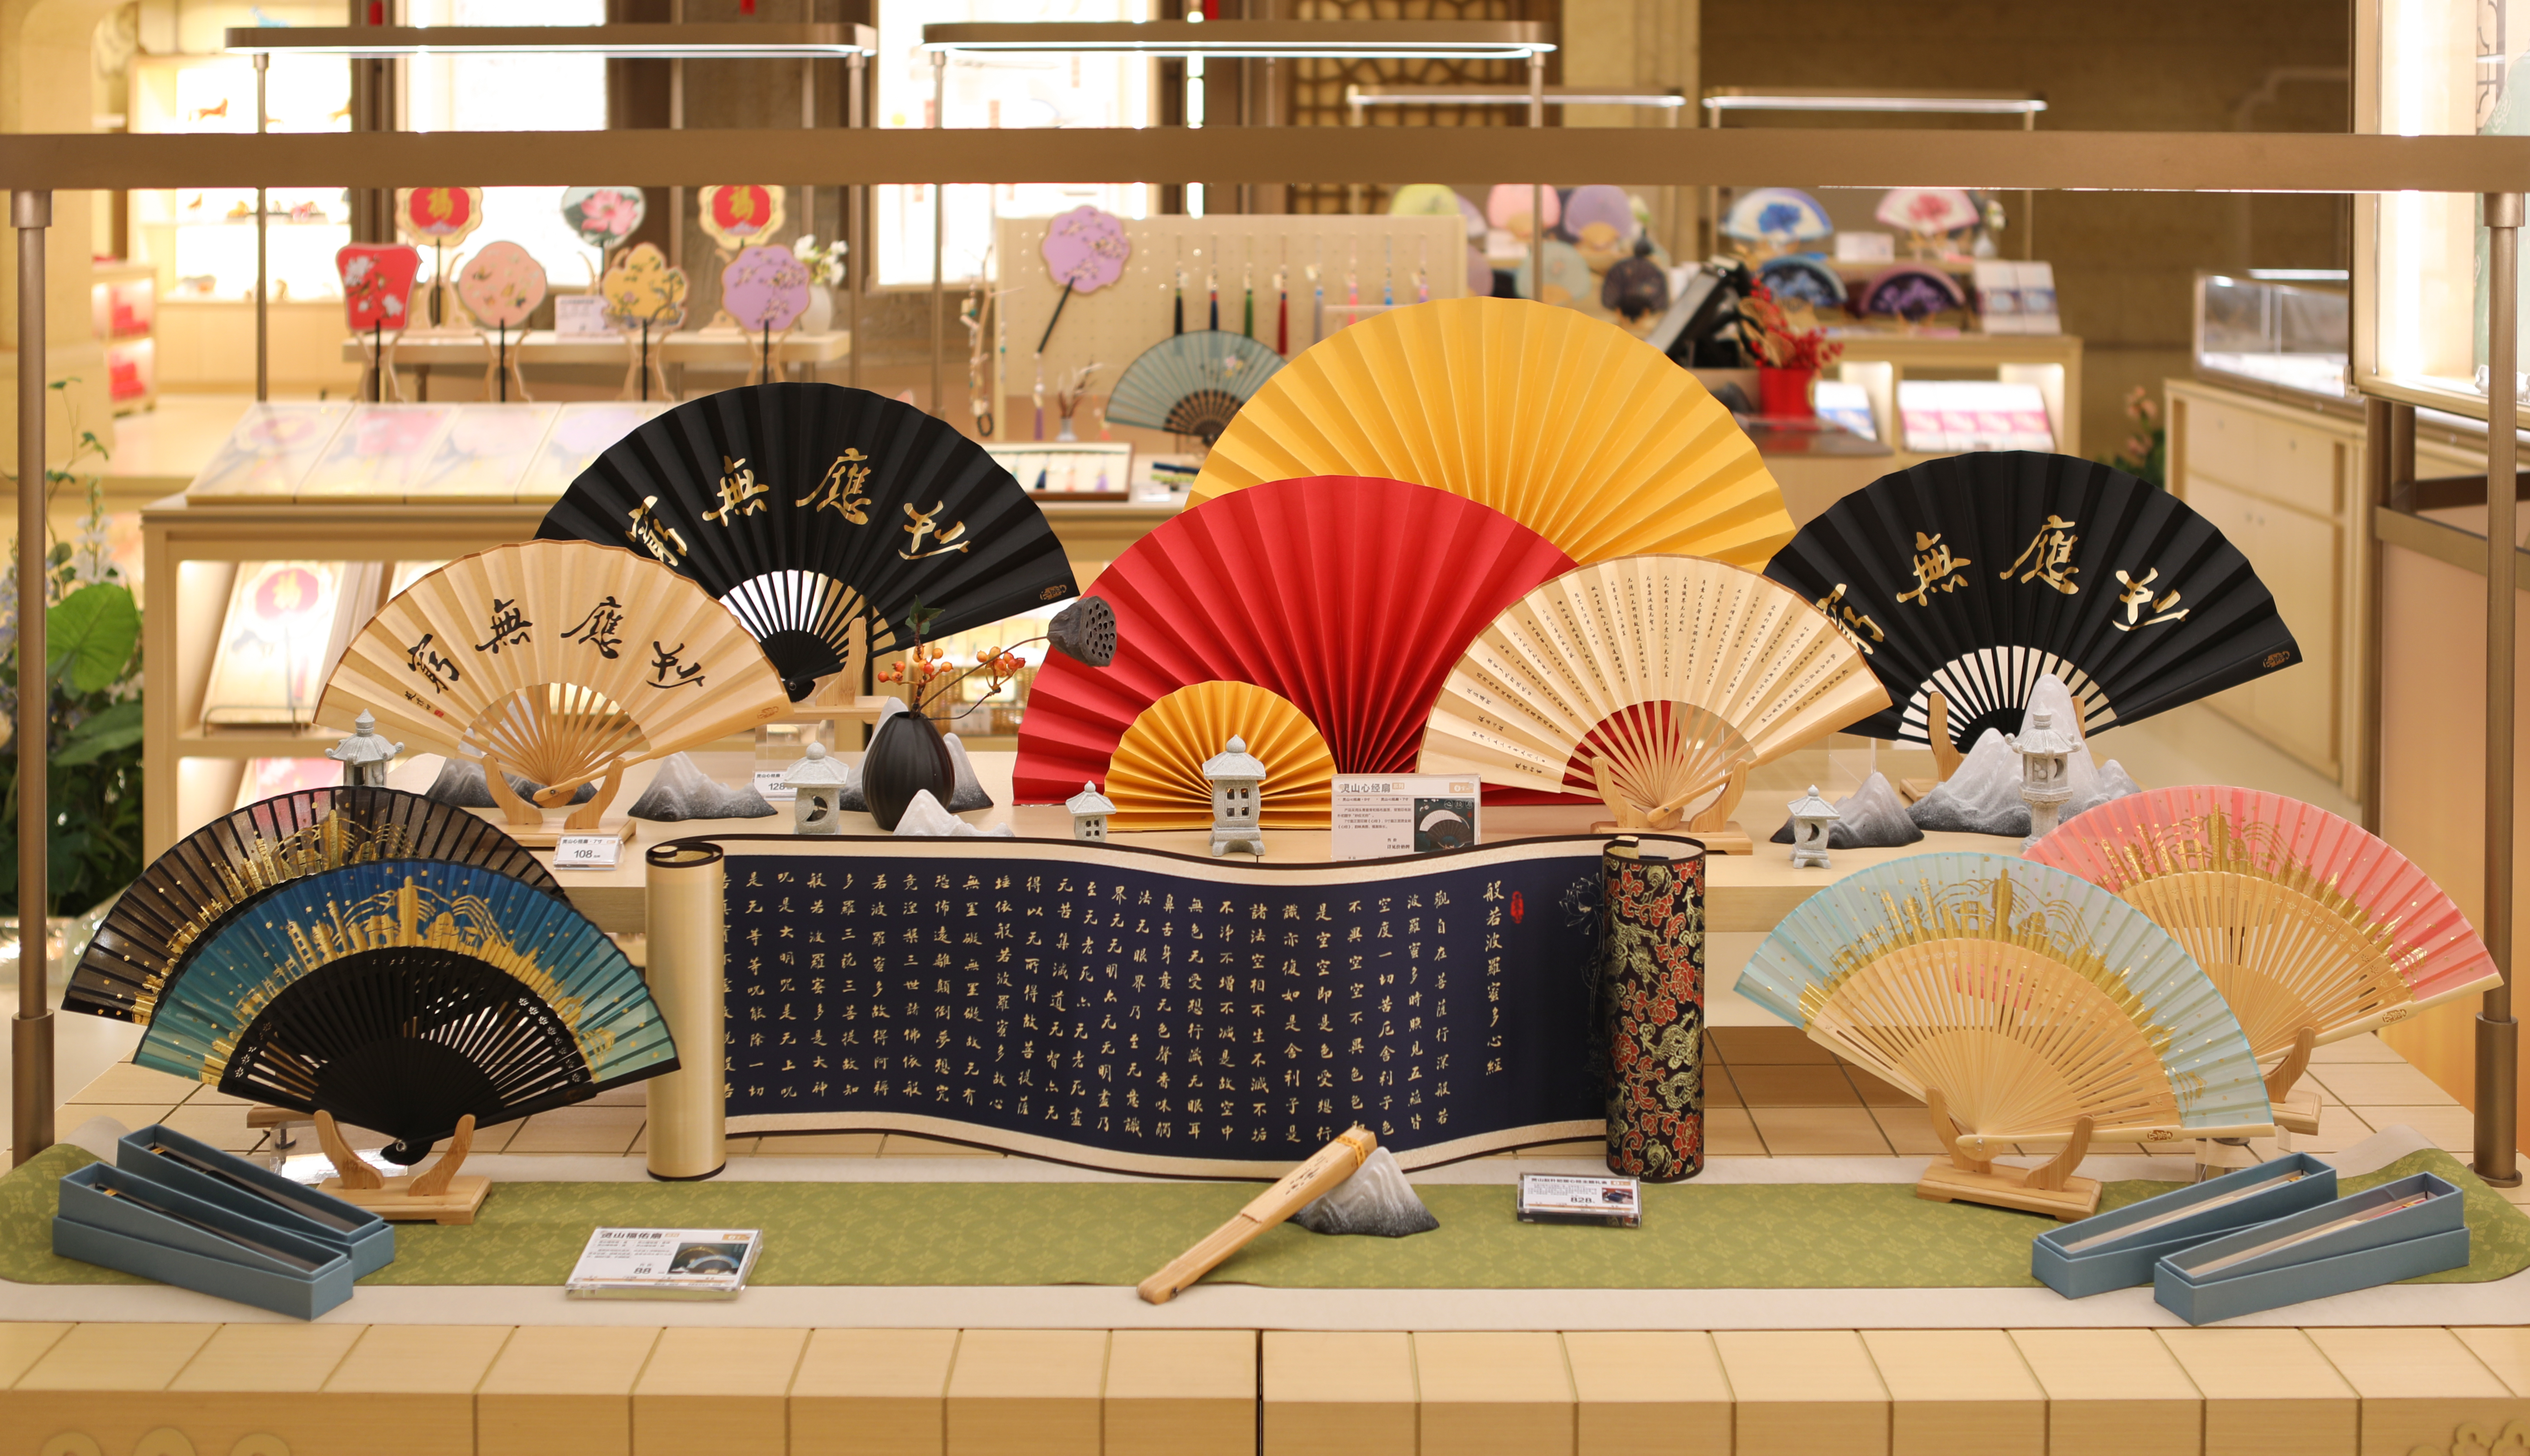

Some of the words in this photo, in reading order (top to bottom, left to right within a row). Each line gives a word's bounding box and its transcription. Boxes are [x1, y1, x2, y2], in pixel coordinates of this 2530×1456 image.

[1341, 783, 1391, 793] 灵山心经扇
[574, 850, 593, 858] 108
[1482, 880, 1505, 1076] 般若波羅蜜多心經
